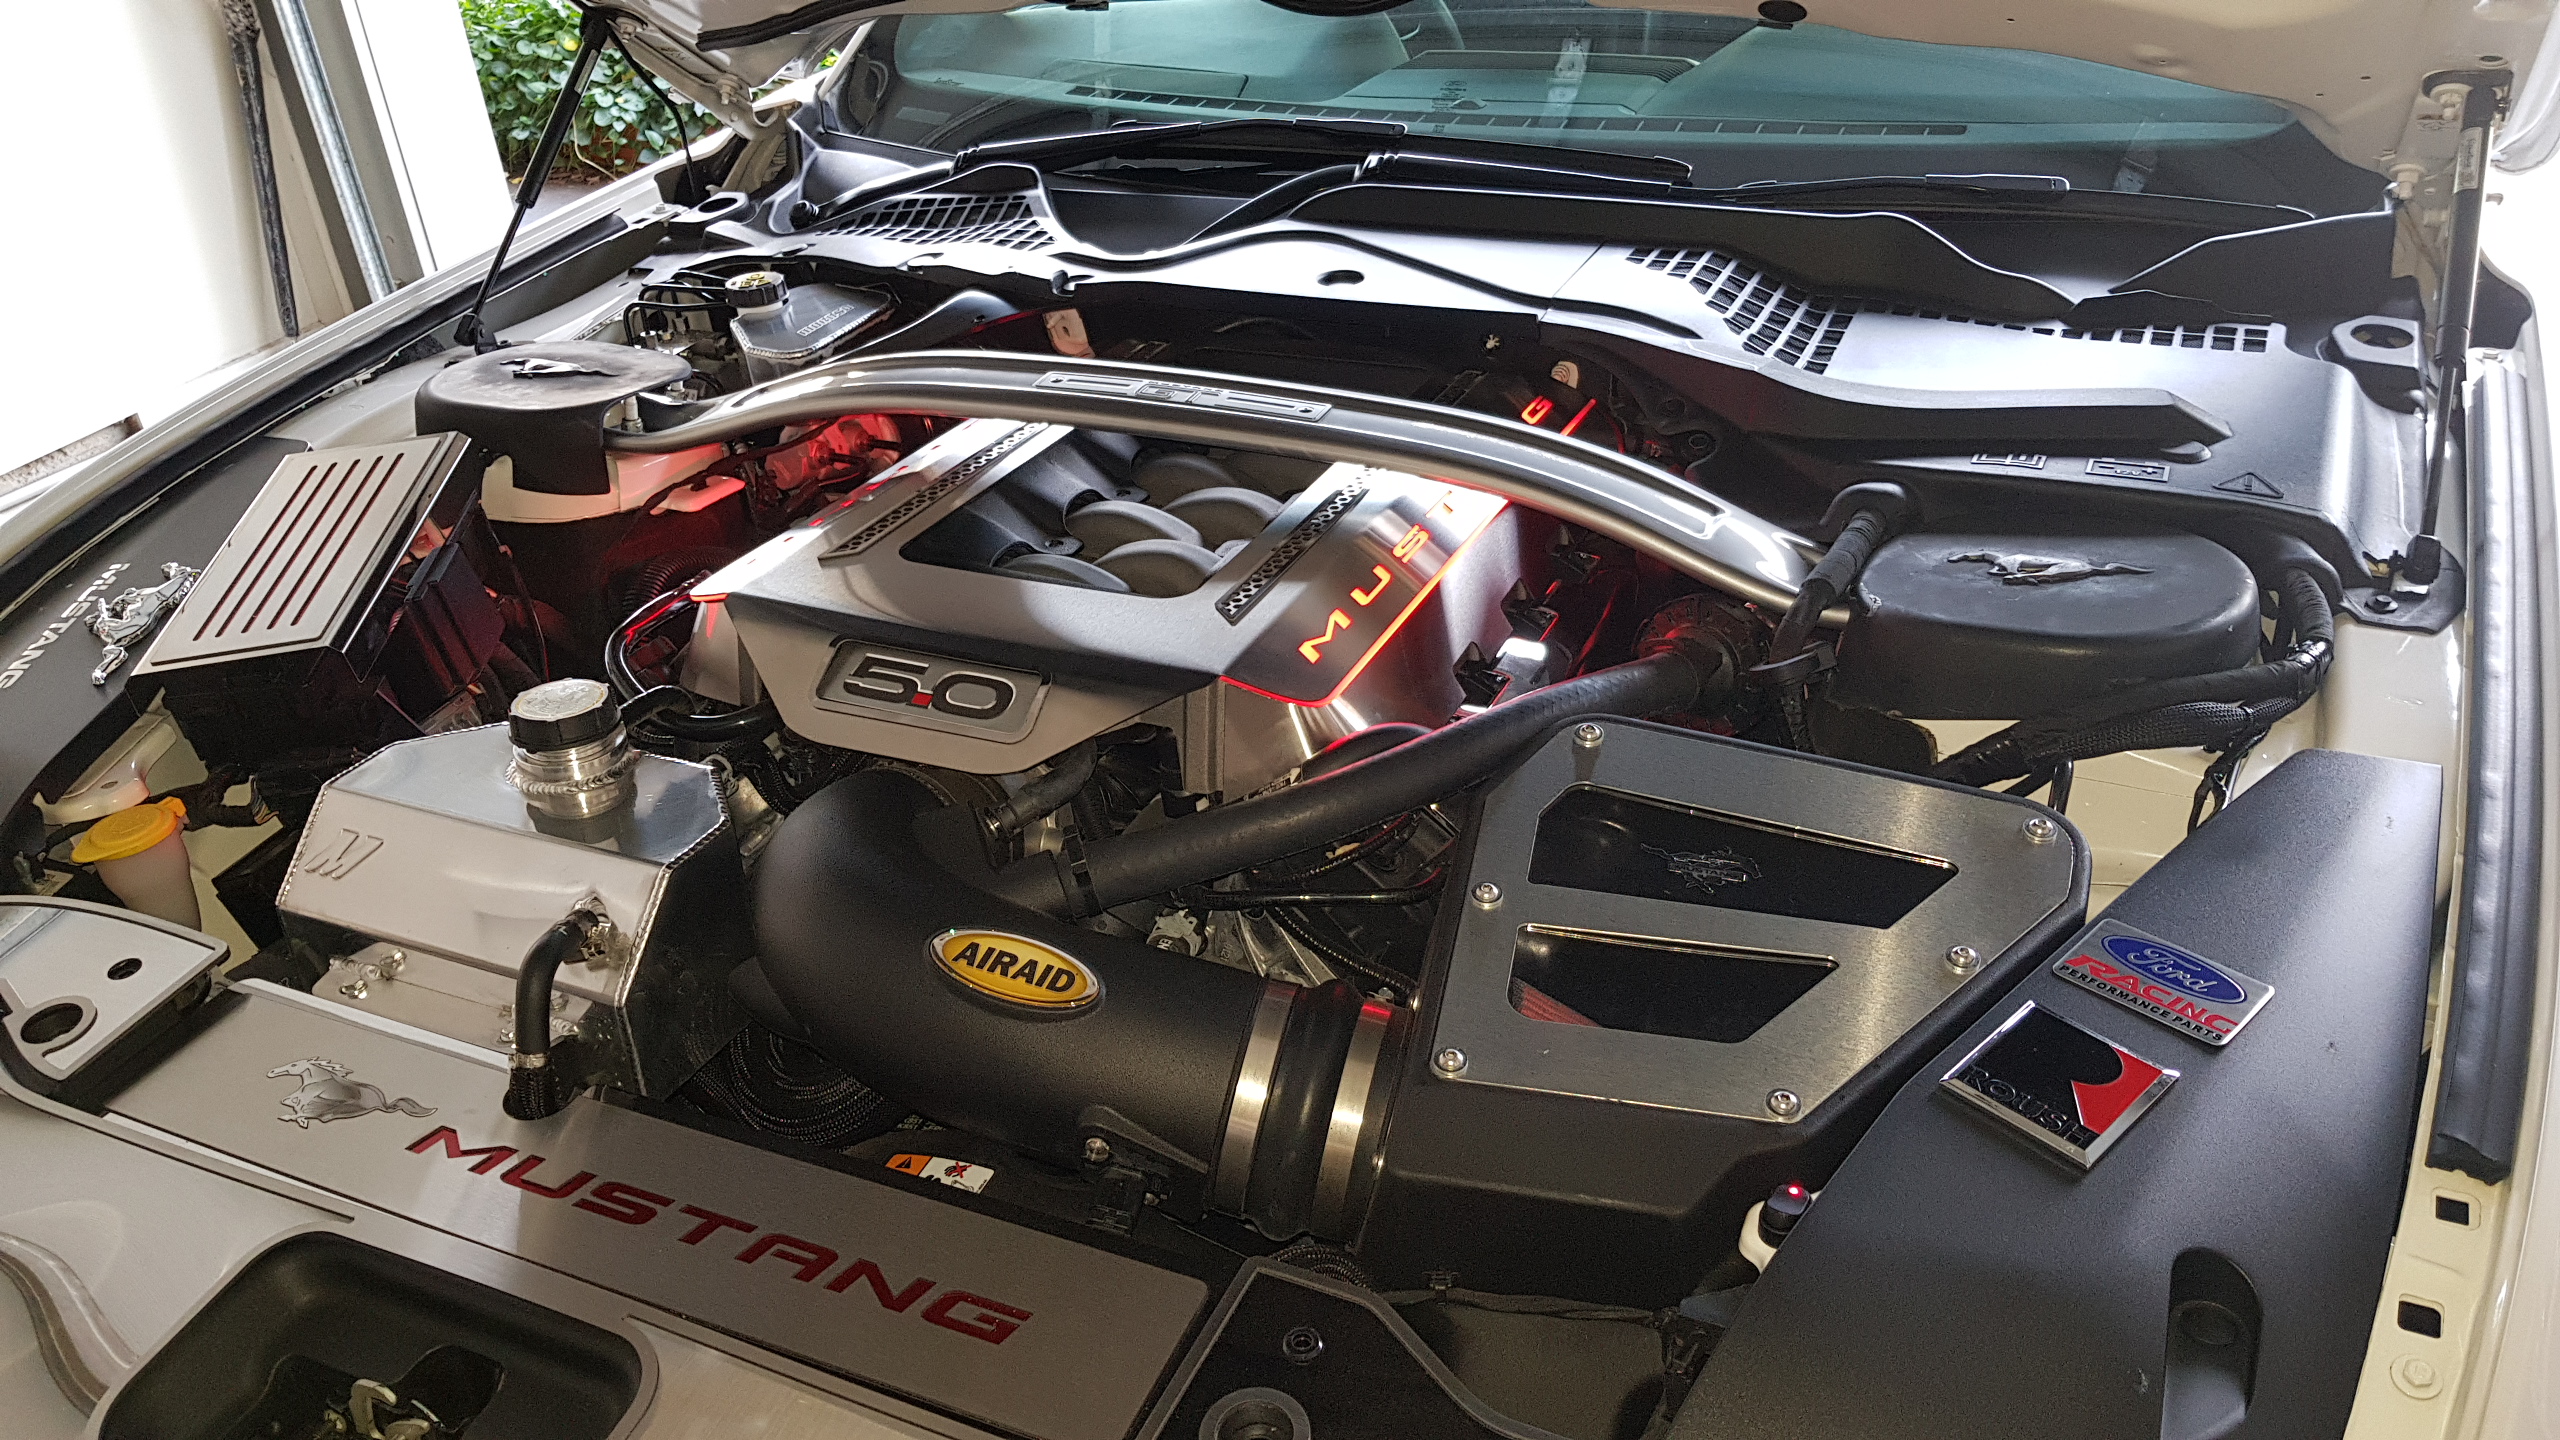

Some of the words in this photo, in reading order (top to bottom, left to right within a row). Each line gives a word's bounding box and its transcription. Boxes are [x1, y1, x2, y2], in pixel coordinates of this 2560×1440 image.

[1134, 383, 1223, 405] GT
[0, 562, 131, 689] MUSTANG
[842, 652, 1017, 720] 5.0
[951, 941, 1077, 993] AIRAID
[2059, 964, 2175, 1019] PERFORMANCE
[2171, 1014, 2223, 1042] PARTS
[2064, 953, 2241, 1035] RACING
[2127, 947, 2218, 992] Ford
[1963, 1064, 2092, 1147] ROUSH
[404, 1124, 1034, 1345] MUSTANG
